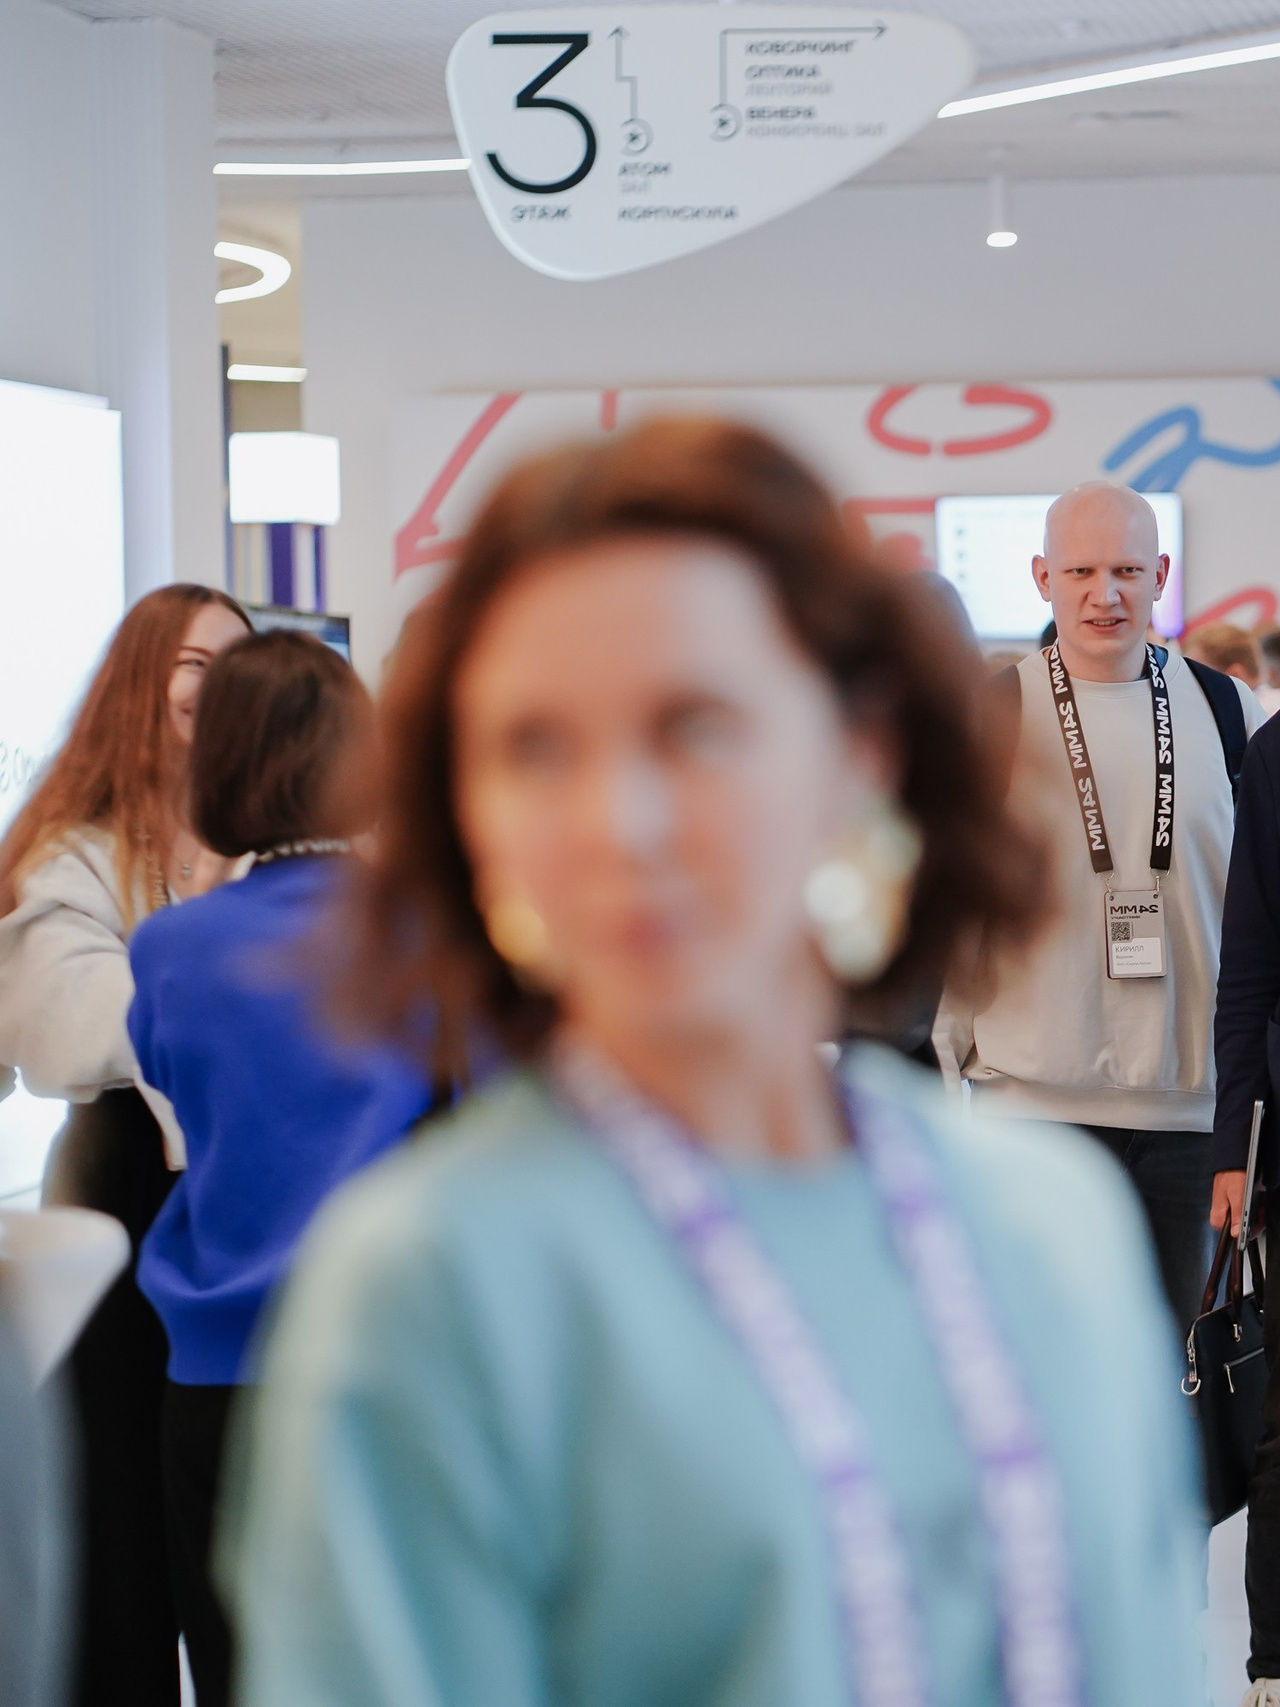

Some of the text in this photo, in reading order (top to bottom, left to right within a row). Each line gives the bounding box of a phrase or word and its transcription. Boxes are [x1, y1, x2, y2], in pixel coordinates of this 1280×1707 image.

[746, 40, 855, 55] КОВОРКИНГ
[486, 33, 597, 194] 3
[618, 162, 671, 177] АТОМ
[511, 204, 570, 221] ЭТАЖ
[1115, 945, 1144, 953] КИРИЛЛ
